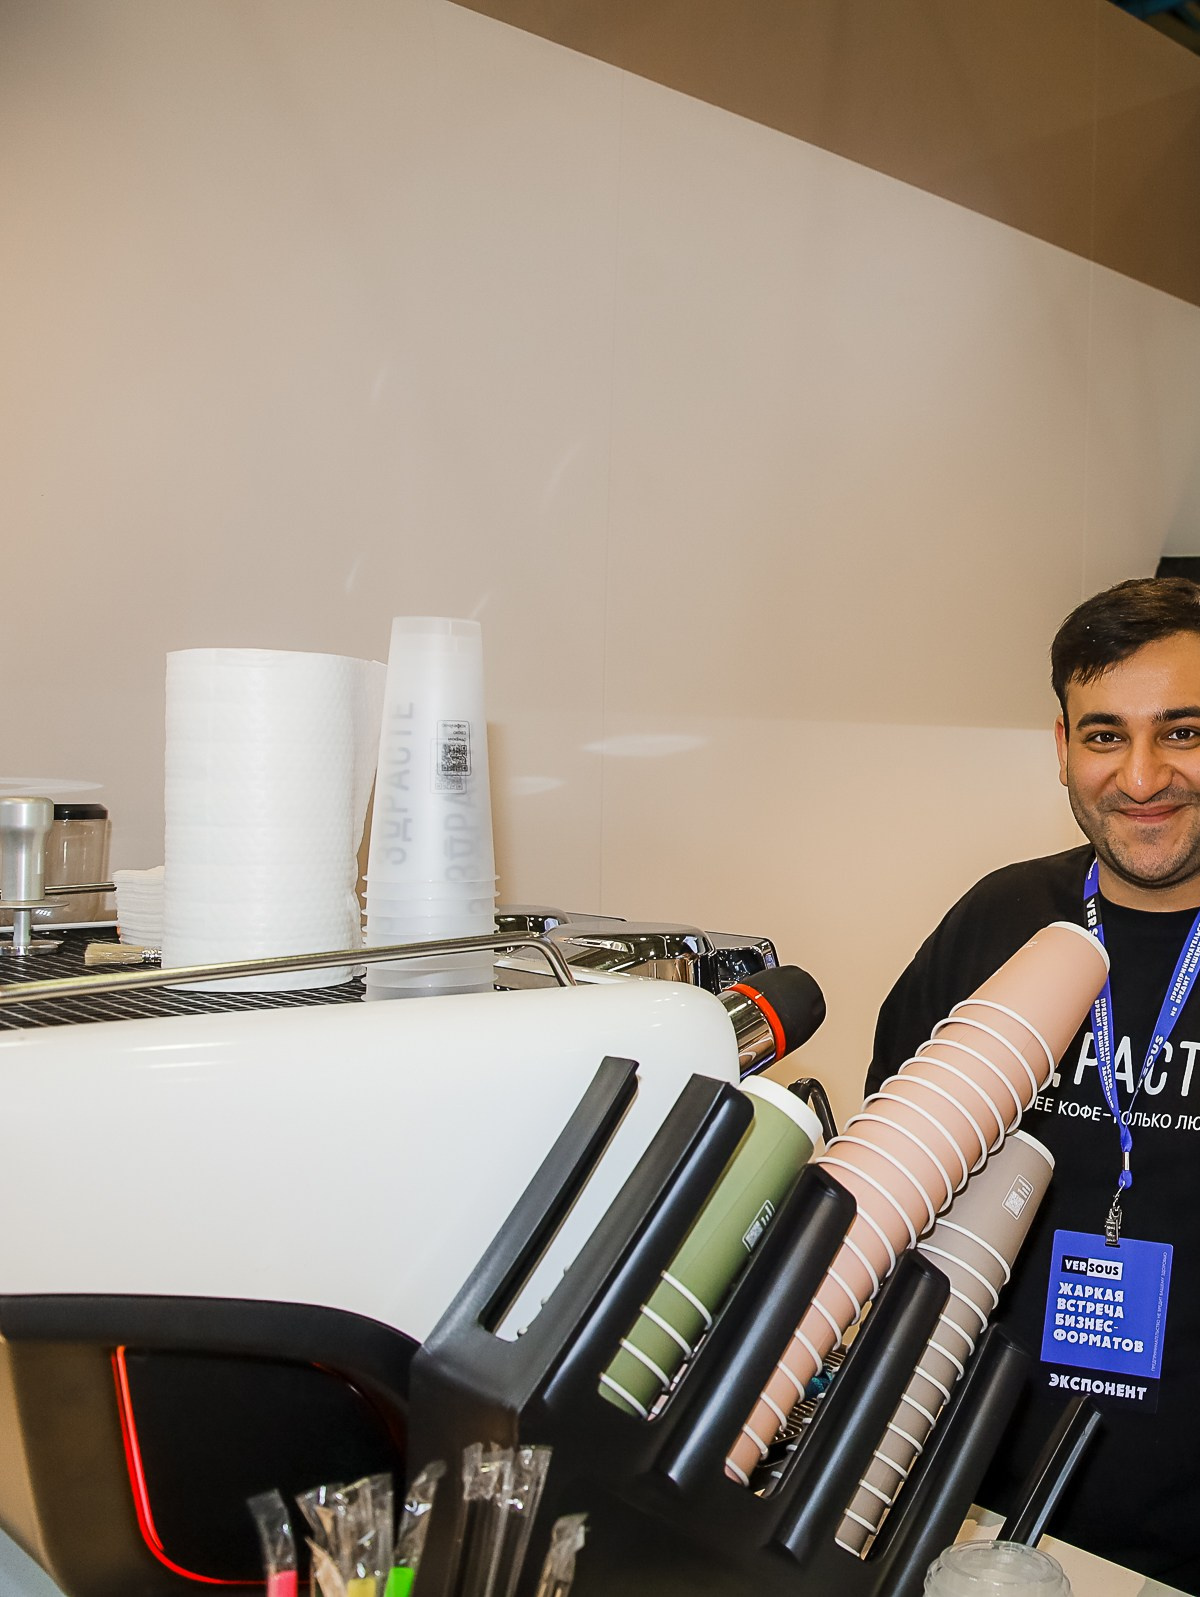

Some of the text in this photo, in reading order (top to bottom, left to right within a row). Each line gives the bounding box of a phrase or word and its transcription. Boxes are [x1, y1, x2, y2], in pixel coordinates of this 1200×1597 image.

[1086, 898, 1100, 936] VERS
[1170, 1006, 1178, 1017] НЕ
[1176, 975, 1191, 1005] ВРЕДИТ
[1058, 1282, 1124, 1302] ЖАРКАЯ
[1057, 1298, 1124, 1318] ВСТРЕЧА
[1055, 1313, 1119, 1333] БИЗНЕС-
[1053, 1329, 1144, 1353] ФОРМАТОВ
[1048, 1374, 1147, 1400] ЭКСПОНЕНТ
